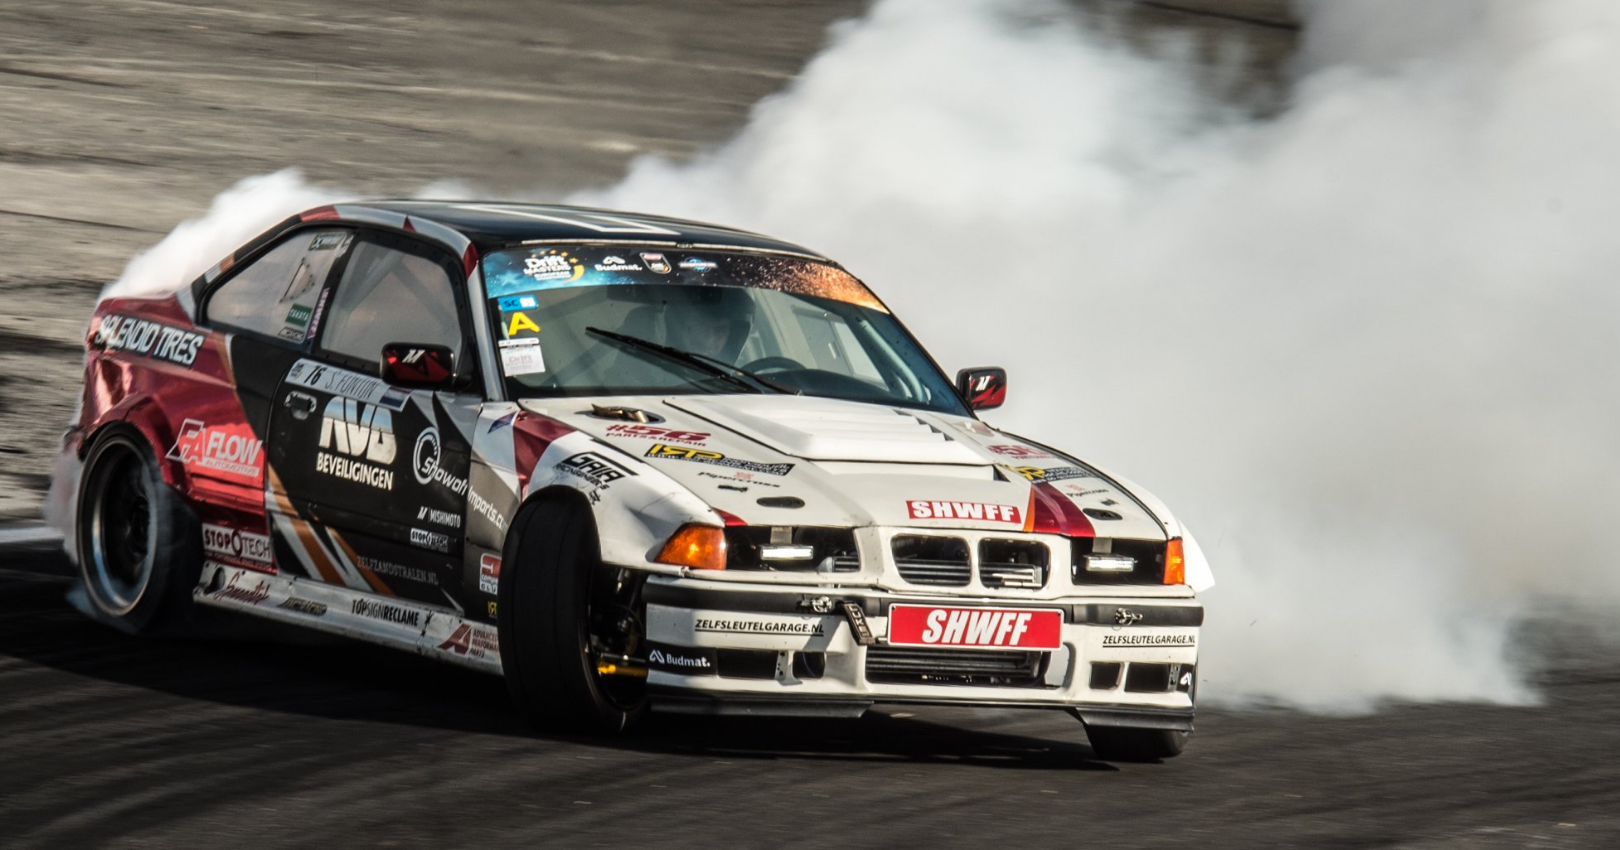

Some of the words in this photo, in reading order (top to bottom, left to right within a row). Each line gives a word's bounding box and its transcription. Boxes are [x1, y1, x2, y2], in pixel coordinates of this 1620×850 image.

[503, 299, 518, 307] SC
[508, 311, 541, 336] A
[94, 314, 157, 353] SPLENDID
[154, 327, 204, 365] TIRES
[304, 365, 327, 386] 76
[606, 424, 711, 441] #56
[206, 431, 263, 465] FLOW
[316, 451, 394, 491] BEVEILIGINGEN
[430, 508, 461, 528] MISHIMOTO
[911, 501, 1016, 522] SHWFF
[357, 556, 439, 586] ZELFZANDSTRALEN.NL
[351, 598, 420, 627] TOPSIGNRECLAME
[695, 618, 824, 634] ZELFSLEUTELGARAGE.NL
[921, 608, 1032, 647] SHWFF
[1102, 635, 1195, 645] ZELFSLEUTELGARAGE.NL
[666, 653, 711, 668] Budmat.
